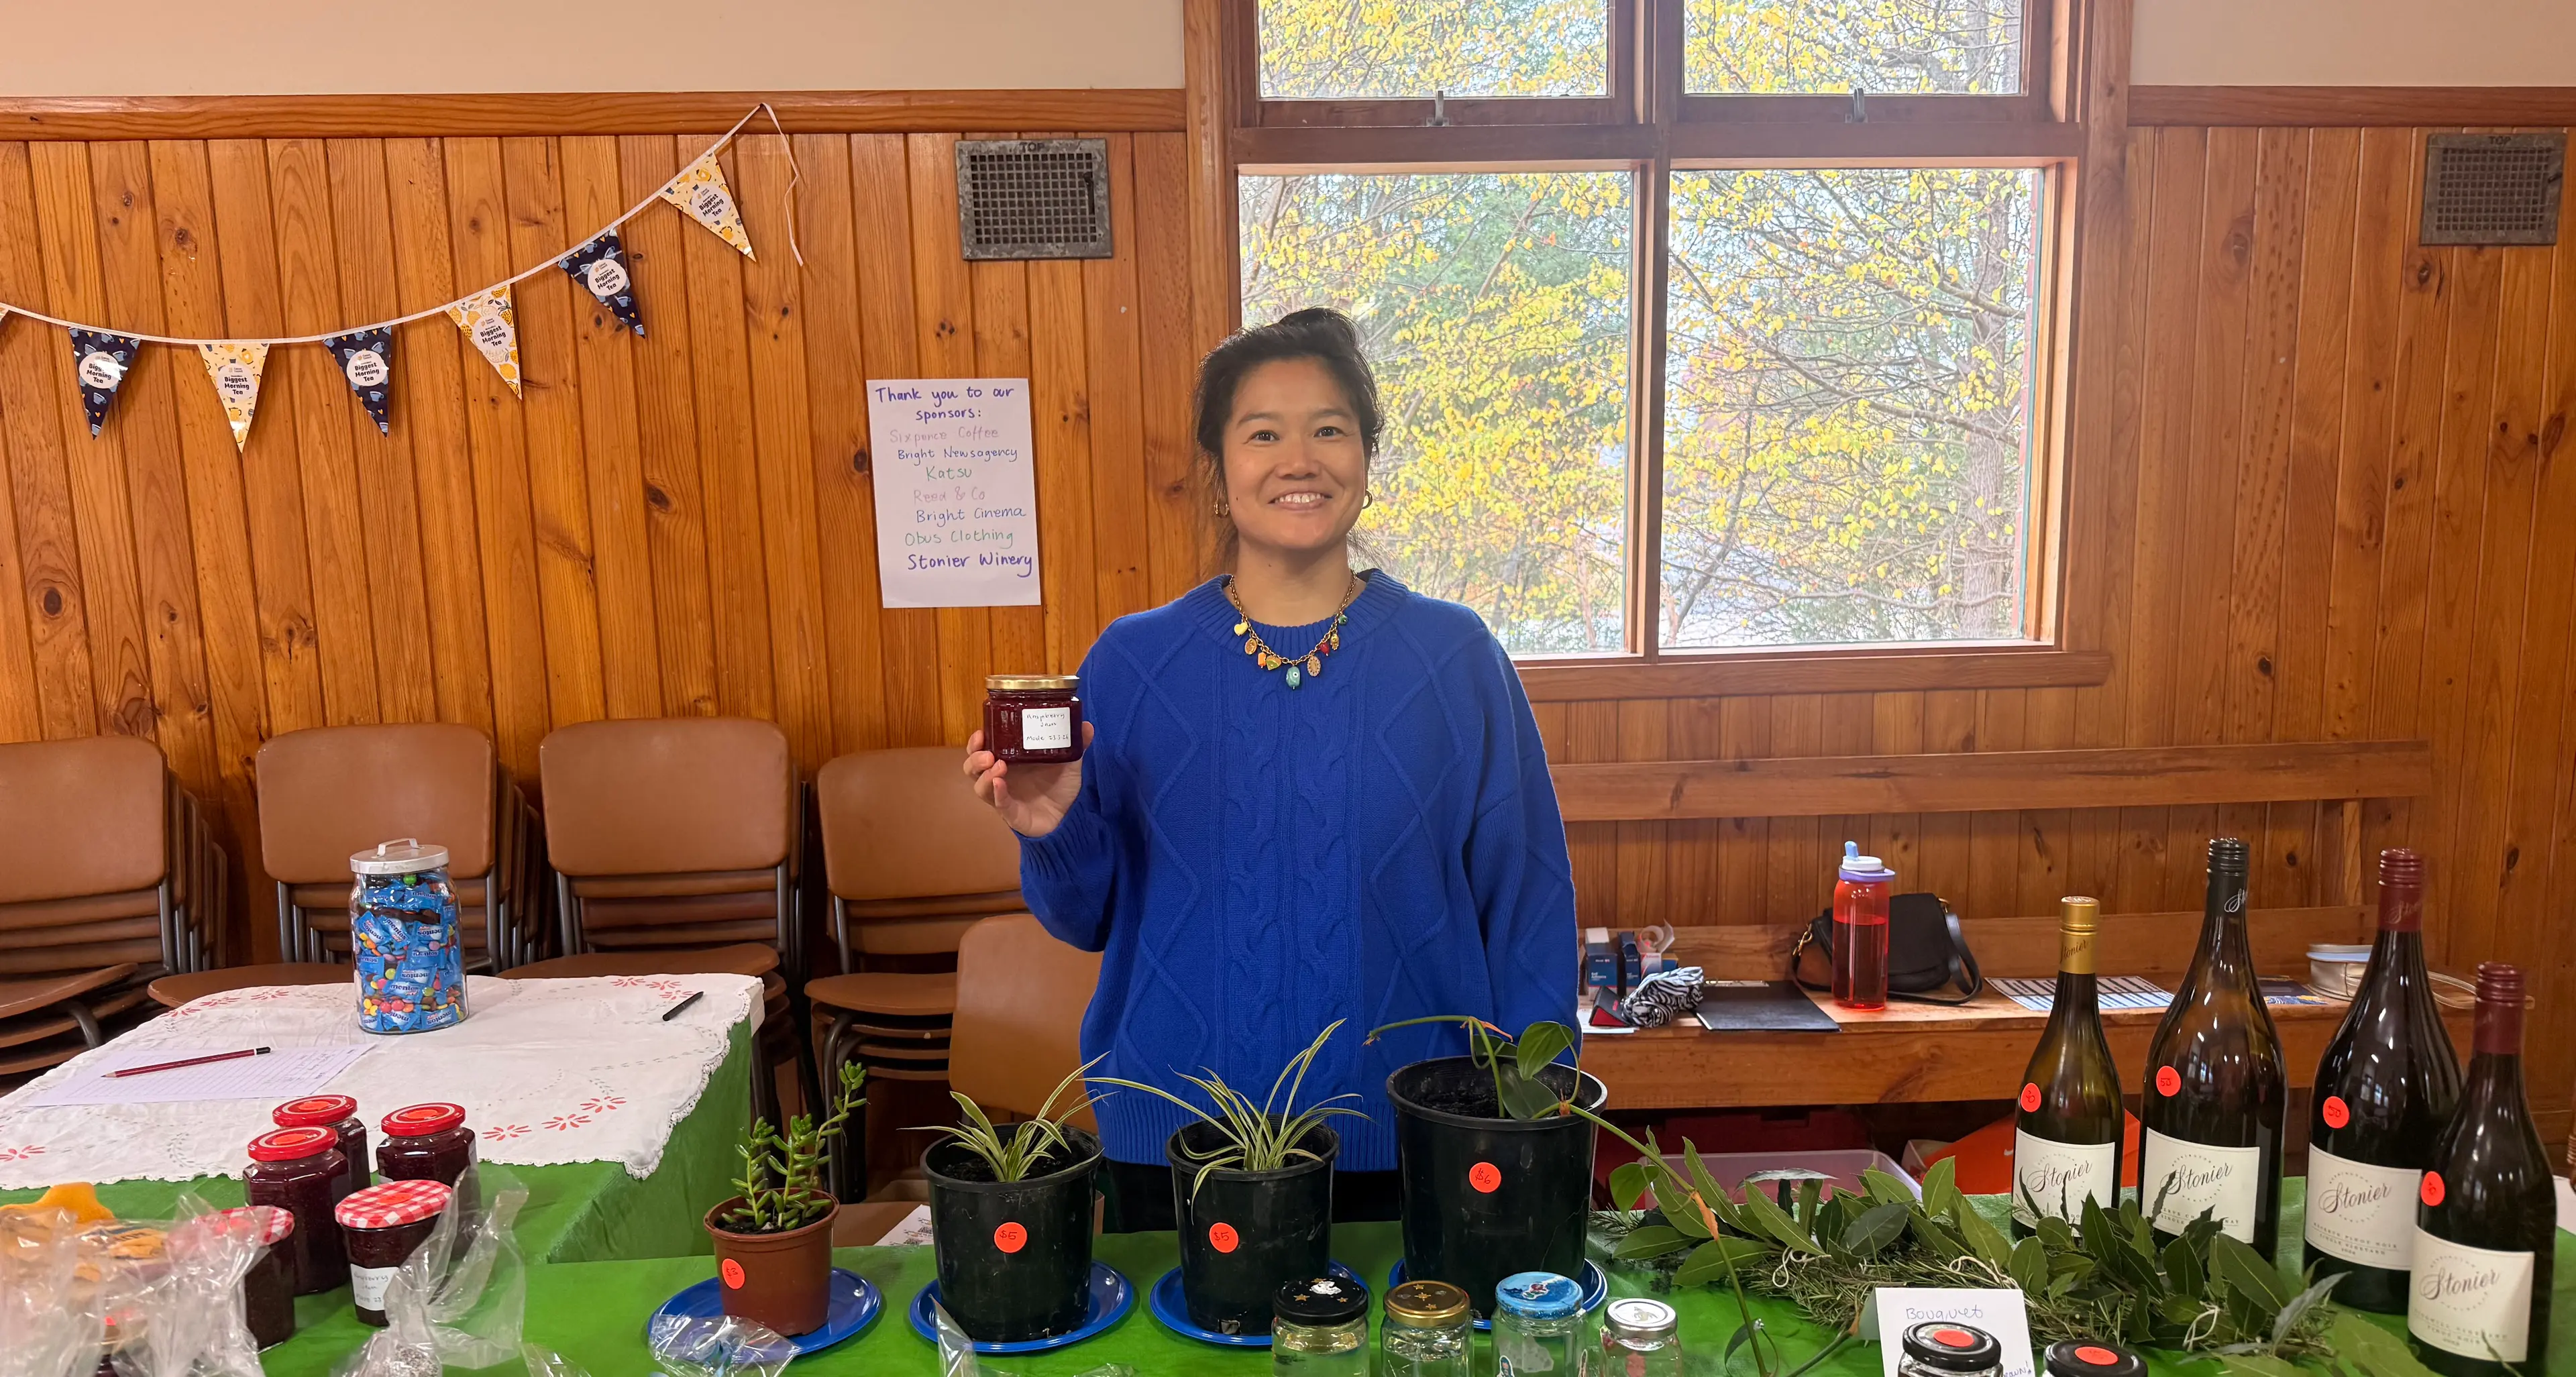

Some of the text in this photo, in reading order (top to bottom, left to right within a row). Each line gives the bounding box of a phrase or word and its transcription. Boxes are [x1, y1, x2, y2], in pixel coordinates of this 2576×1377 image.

[1018, 142, 1045, 152] TOP
[2488, 135, 2512, 145] TOP
[698, 194, 718, 211] Biggest
[702, 199, 724, 217] Morning
[711, 208, 722, 217] Tea
[594, 268, 615, 283] Biggest
[597, 274, 620, 290] Morning
[480, 325, 502, 337] Biggest
[482, 332, 506, 343] Morning
[354, 362, 377, 371] Biggest
[355, 369, 380, 377] Morning
[86, 370, 111, 380] Morning
[875, 386, 1014, 407] Thank you to our
[916, 408, 981, 424] sponsors:
[958, 426, 1000, 441] Coffee
[898, 446, 1018, 465] Bright Newsagency
[925, 466, 972, 482] Katsu
[955, 486, 966, 500] &
[971, 486, 985, 501] Co
[916, 507, 1026, 527] Bright Cinema
[905, 529, 1014, 549] Obus Clothing
[908, 552, 1032, 578] Stonier Winery
[364, 922, 384, 940] mentos
[385, 918, 407, 940] mentos
[427, 1009, 452, 1025] mentos
[2027, 1160, 2092, 1193] Stonier
[2160, 1162, 2233, 1195] Stonier
[2318, 1182, 2392, 1213] Stonier
[1000, 1229, 1018, 1240] $5
[1214, 1231, 1229, 1242] $5
[2420, 1267, 2500, 1300] Stonier
